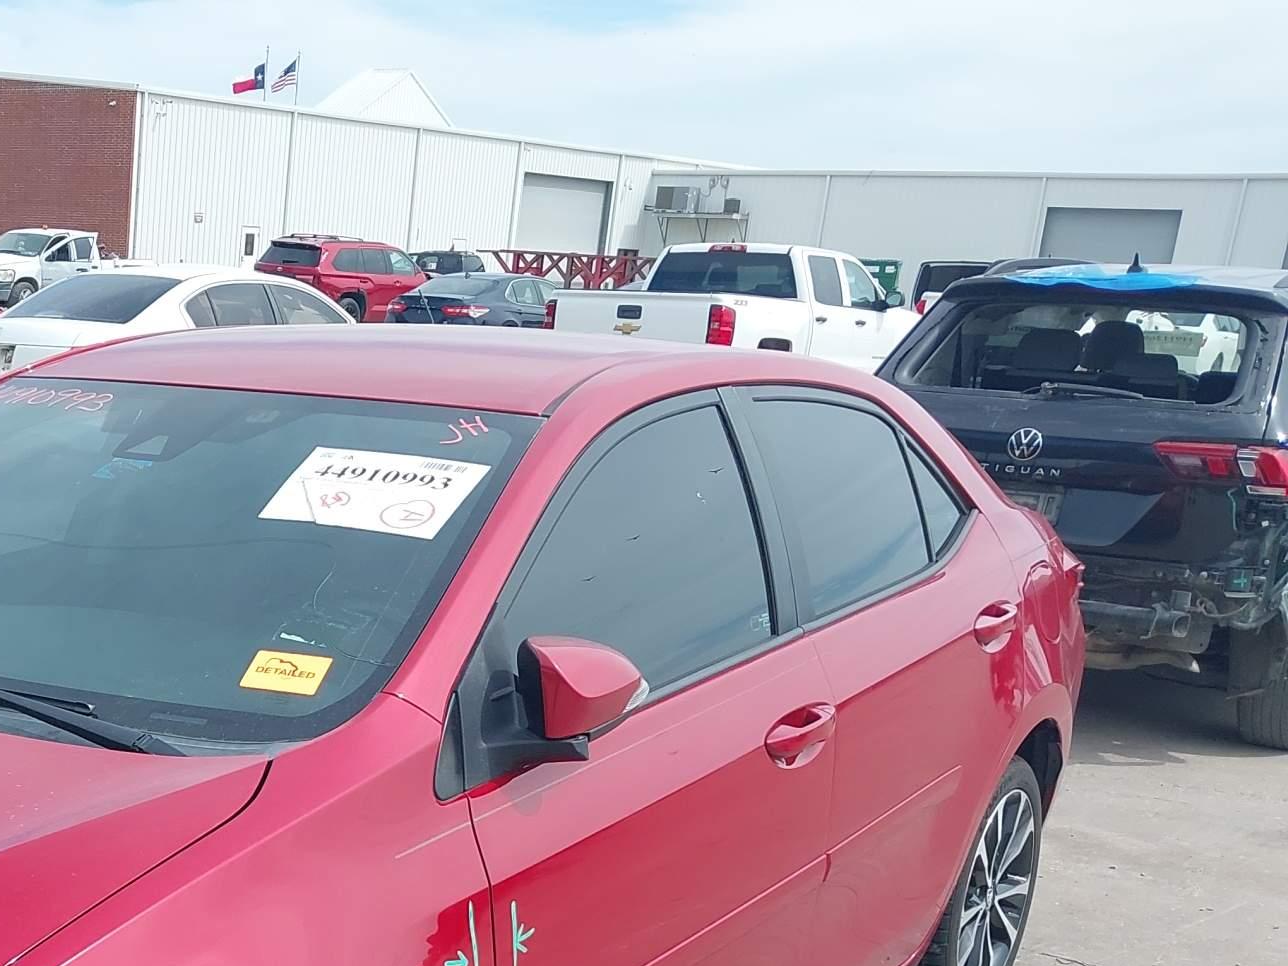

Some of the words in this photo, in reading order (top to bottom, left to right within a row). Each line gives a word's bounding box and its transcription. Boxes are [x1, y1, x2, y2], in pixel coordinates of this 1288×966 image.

[314, 463, 454, 491] 44910993
[980, 463, 1062, 477] TIGUAN
[254, 665, 317, 680] DETAILED
